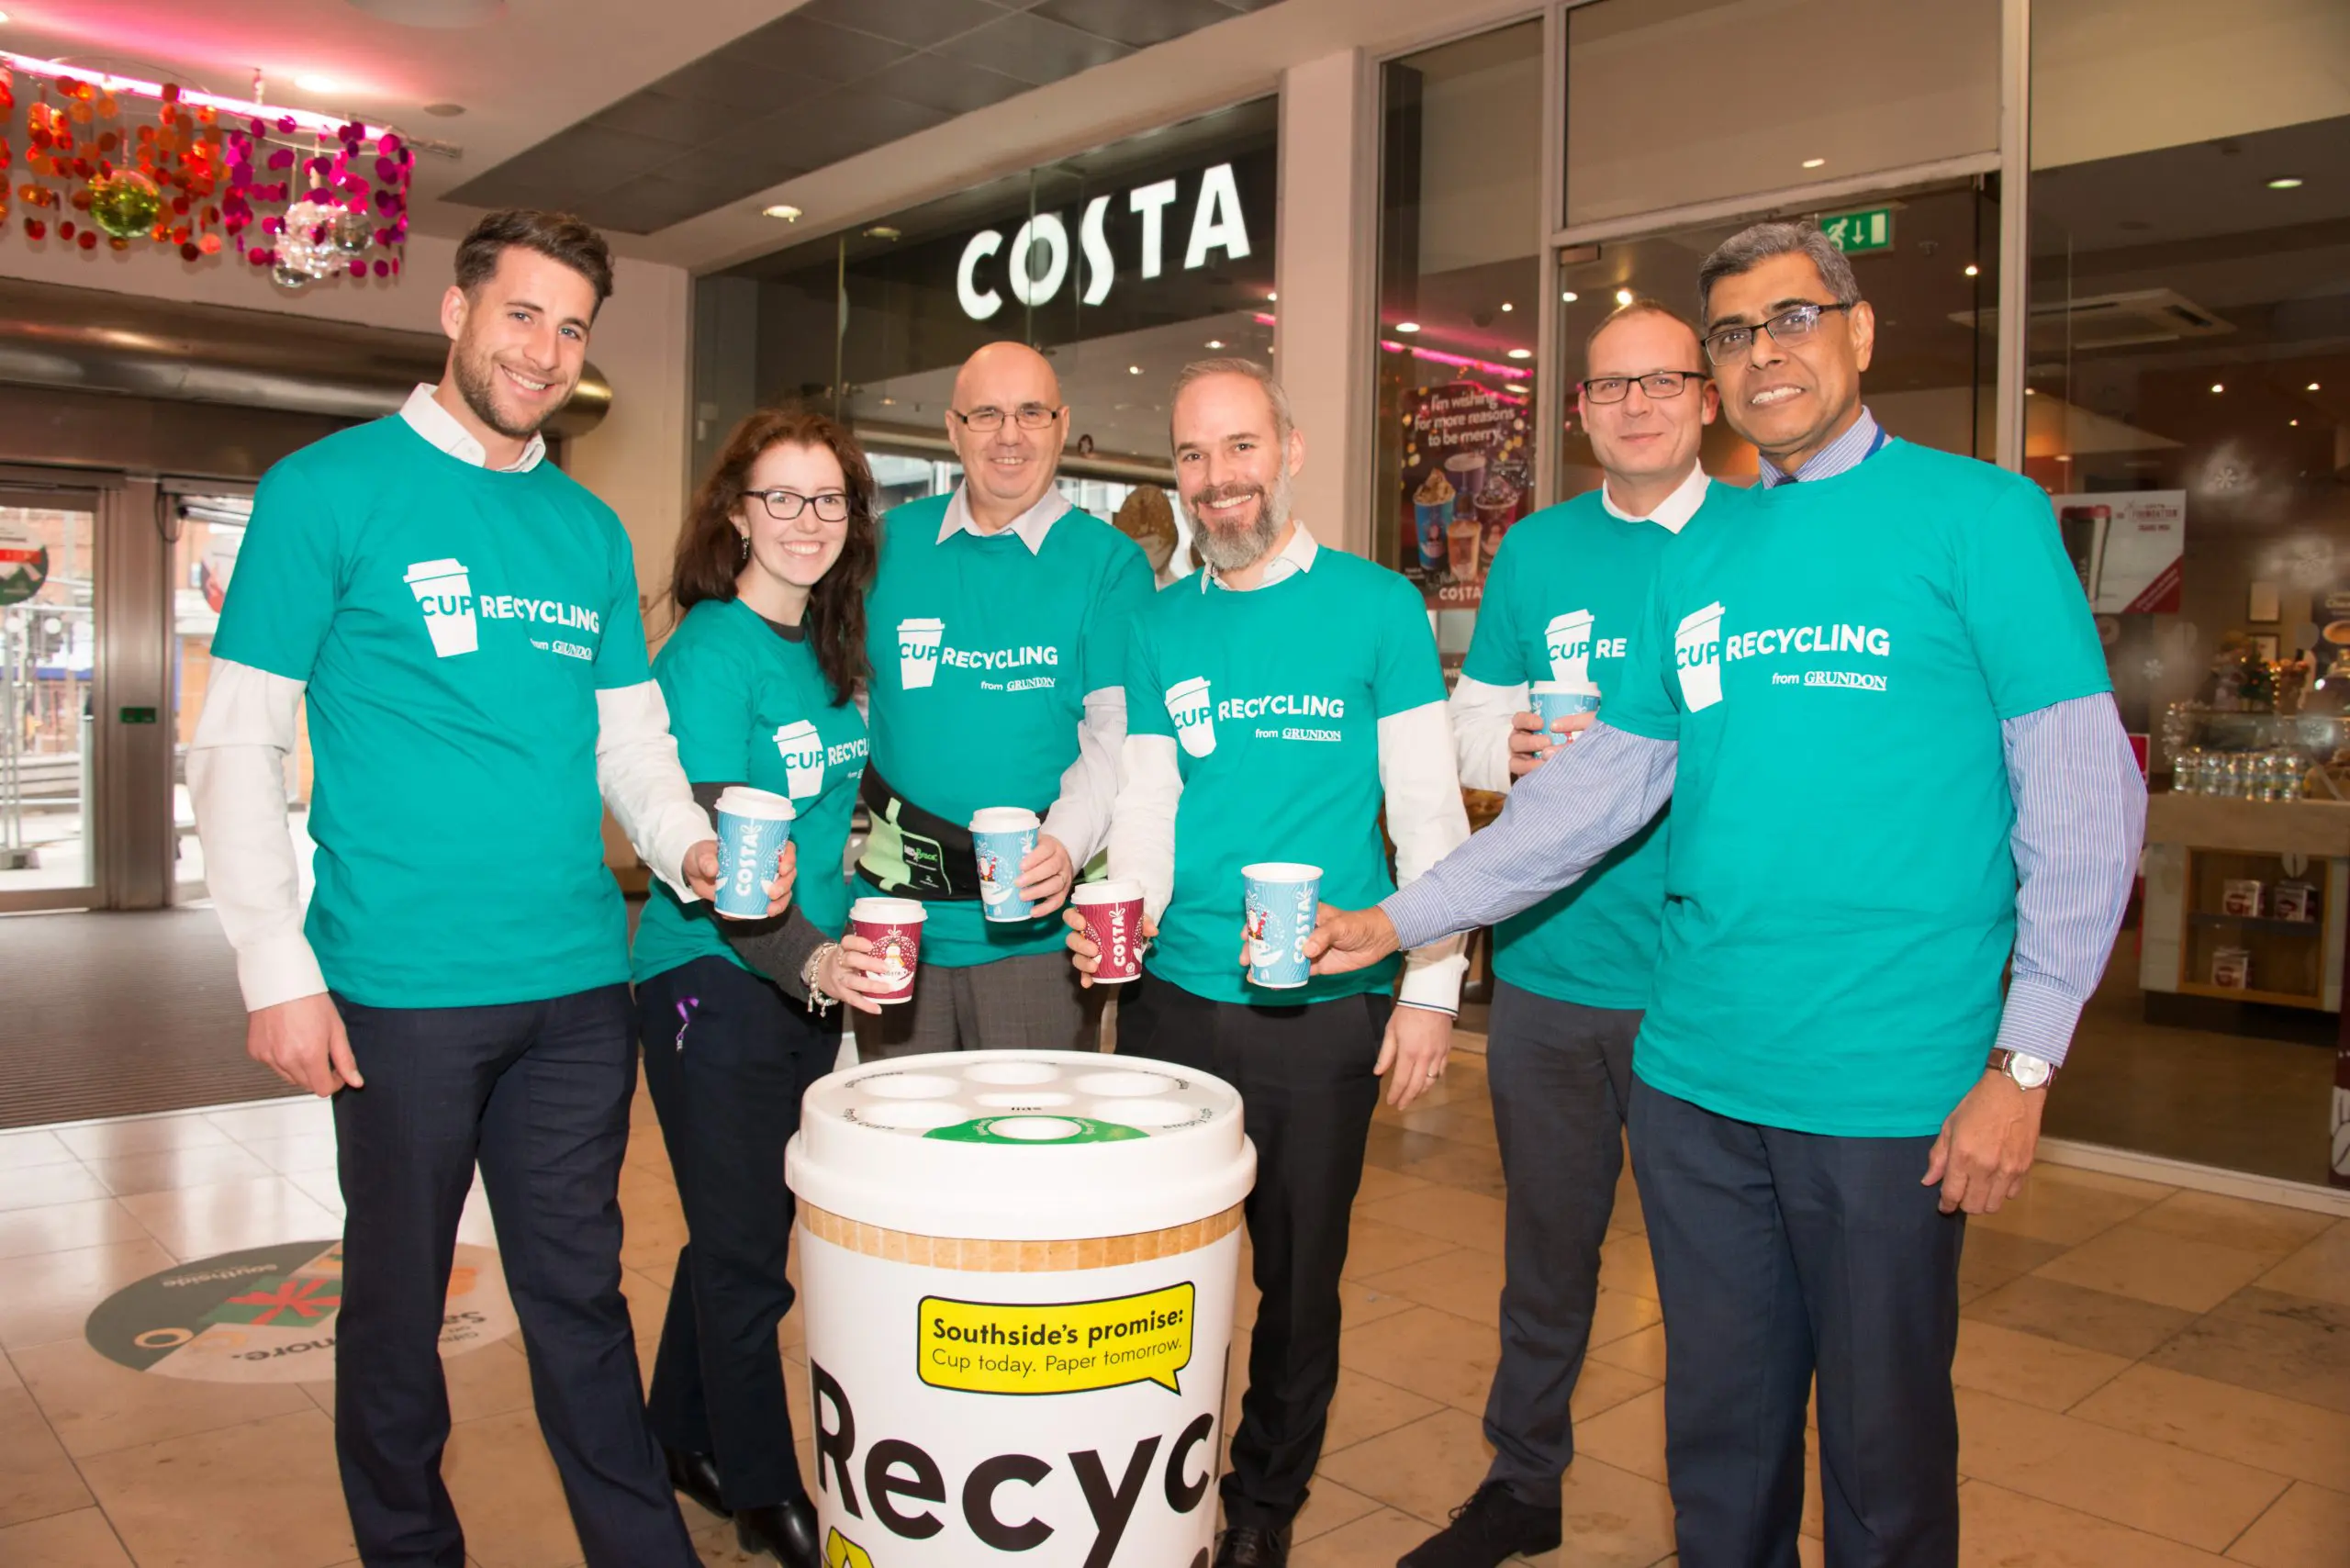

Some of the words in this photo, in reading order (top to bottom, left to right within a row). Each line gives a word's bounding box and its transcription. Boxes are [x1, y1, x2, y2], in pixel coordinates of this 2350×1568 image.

[957, 162, 1251, 319] COSTA
[1431, 395, 1449, 410] I'm
[1451, 390, 1498, 409] wishing
[1414, 414, 1431, 431] for
[1434, 415, 1466, 430] more
[1469, 408, 1515, 423] reasons
[1428, 431, 1441, 446] to
[1443, 428, 1458, 444] be
[1438, 585, 1483, 602] COSTA
[420, 595, 474, 617] CUP
[480, 594, 599, 634] RECYCLING
[898, 643, 939, 661] CUP
[941, 645, 1058, 670] RECYCLING
[1549, 641, 1591, 661] CUP
[1675, 641, 1721, 670] CUP
[1726, 624, 1890, 662] RECYCLING
[980, 680, 1003, 690] from
[1772, 673, 1800, 685] from
[1804, 671, 1888, 691] GRUNDON
[1174, 707, 1213, 730] CUP
[1218, 694, 1345, 722] RECYCLING
[1255, 728, 1279, 739] from
[1281, 727, 1342, 742] GRUNDON
[784, 751, 824, 769] CUP
[735, 834, 758, 897] COSTA
[1112, 915, 1127, 967] COSTA
[1292, 900, 1311, 964] COSTA
[162, 1263, 278, 1287] southside
[1088, 1308, 1184, 1349] promise:
[932, 1348, 971, 1373] Cup
[979, 1354, 1036, 1379] today.
[1046, 1353, 1096, 1375] Paper
[1103, 1337, 1182, 1367] tomorrow.
